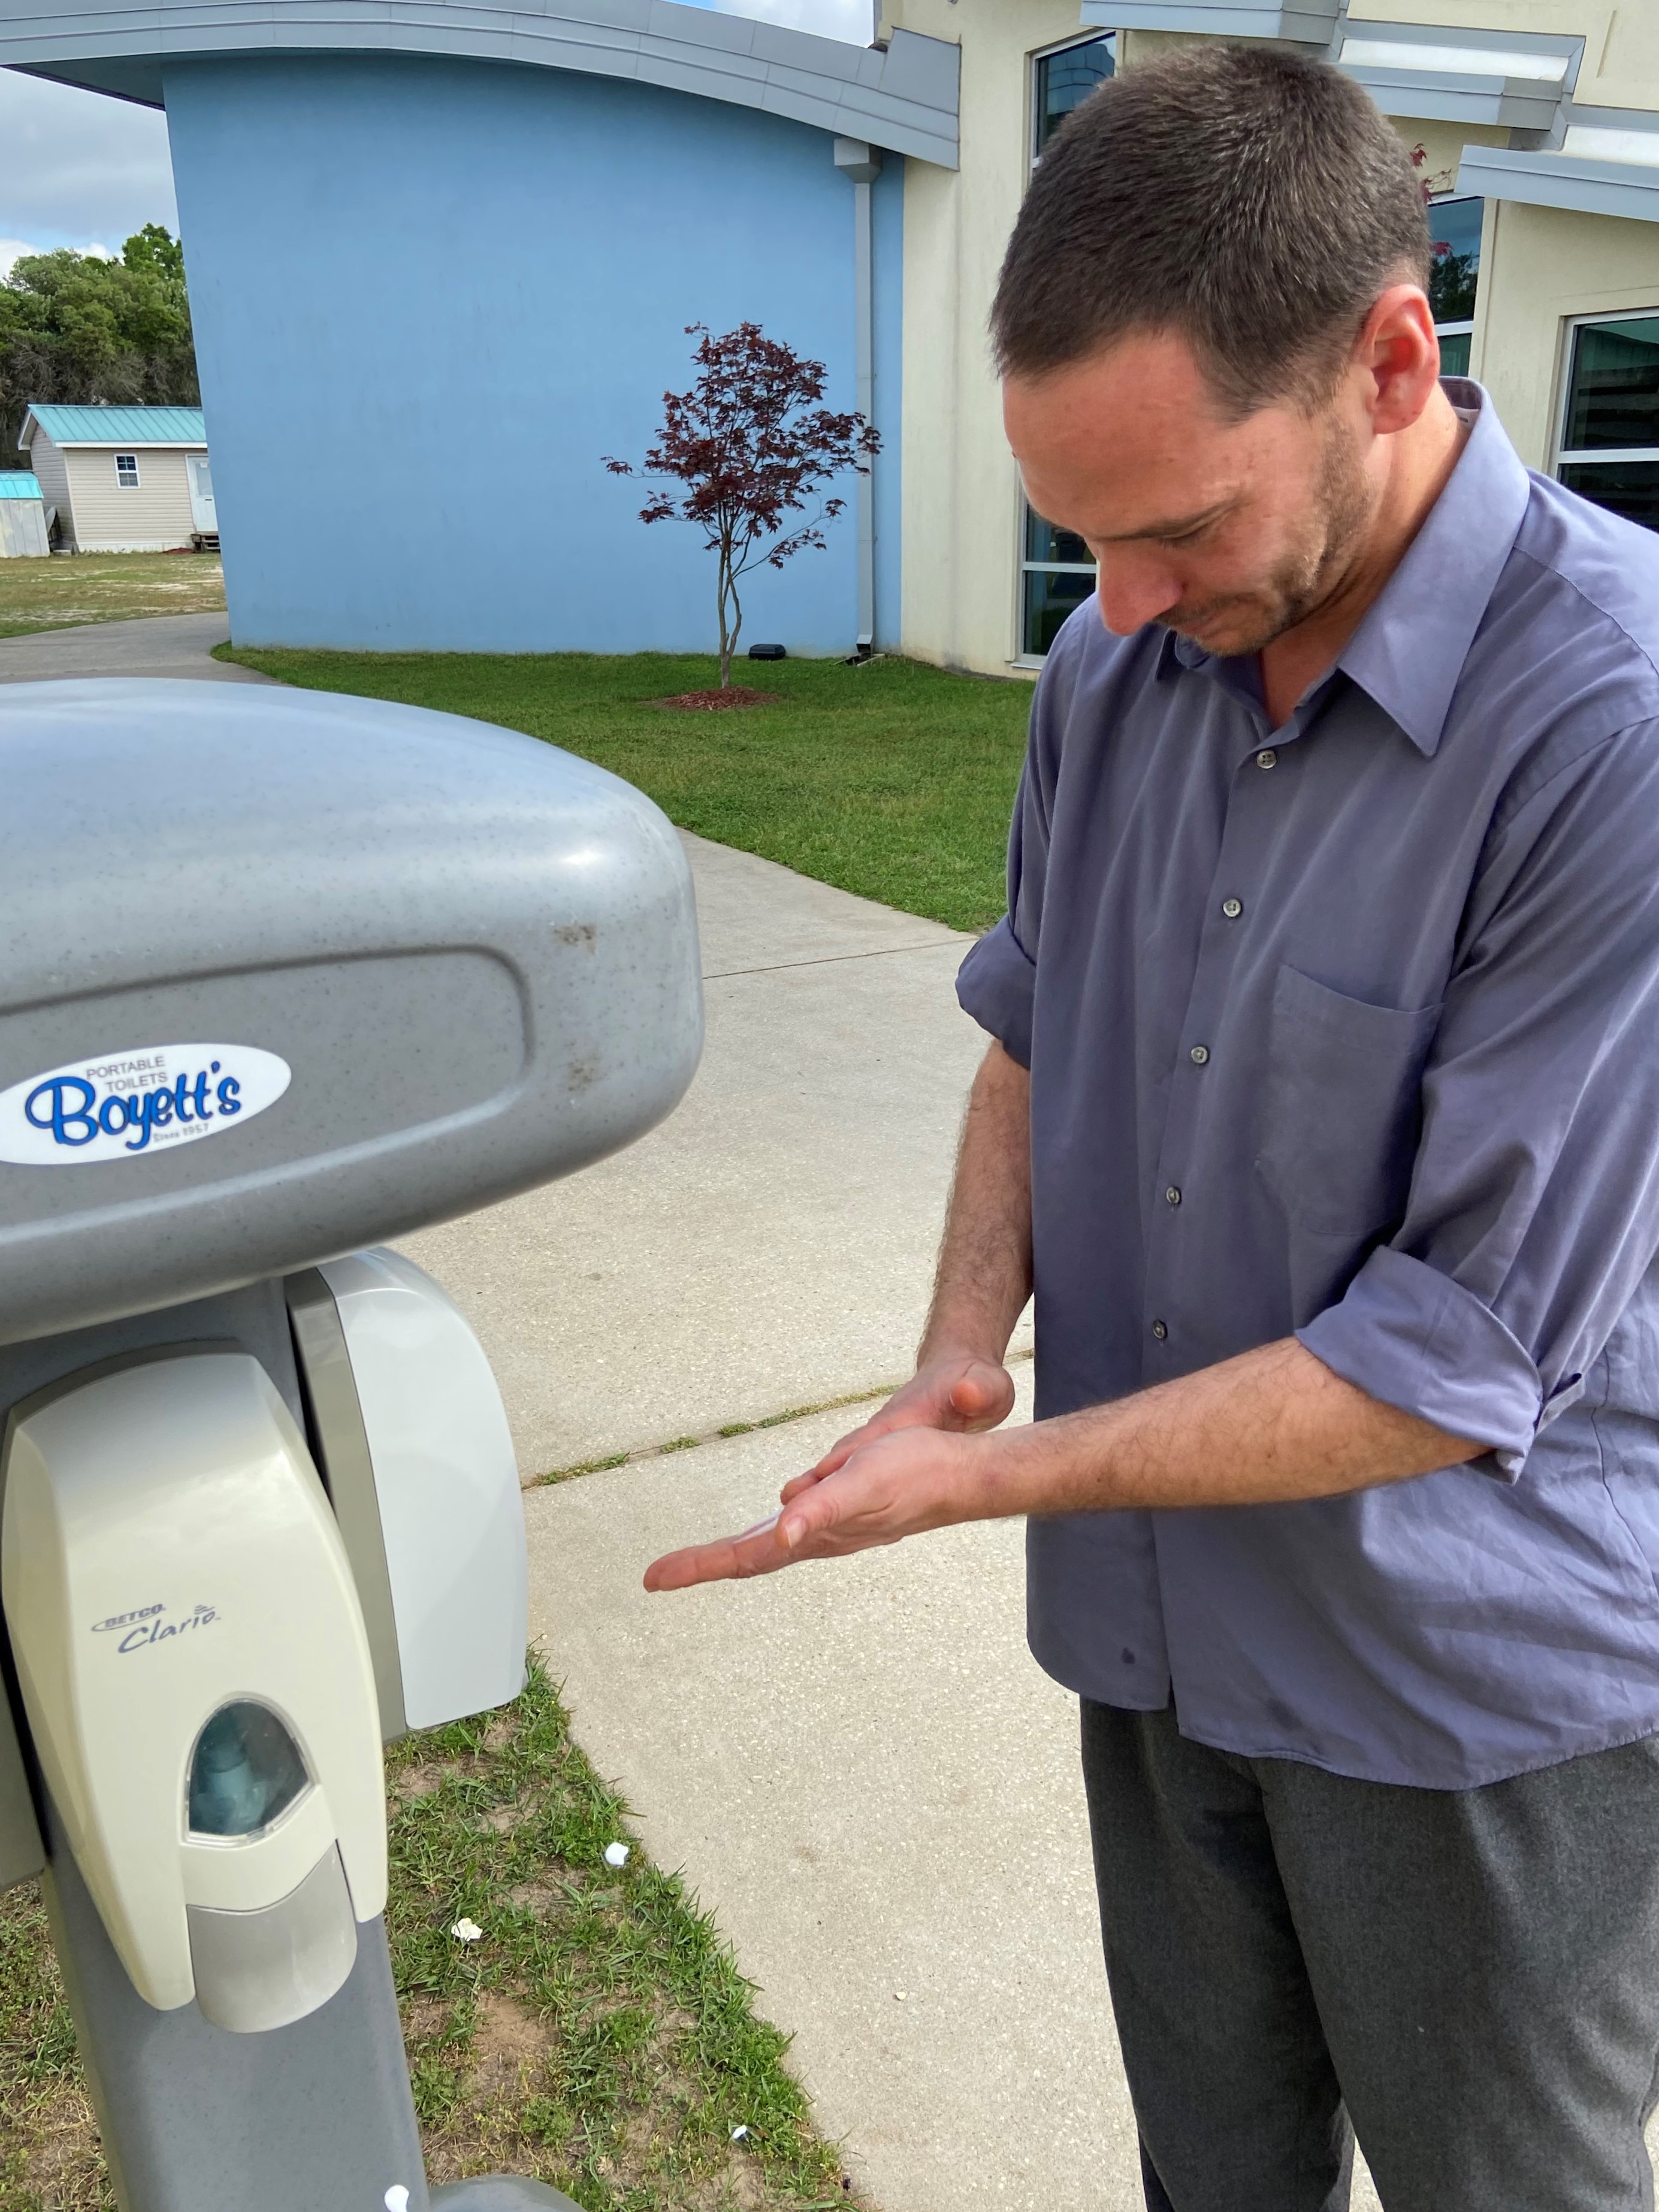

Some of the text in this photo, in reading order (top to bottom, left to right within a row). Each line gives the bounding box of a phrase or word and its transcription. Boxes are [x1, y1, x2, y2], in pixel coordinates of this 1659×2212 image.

[86, 1056, 165, 1079] PORTABLE
[105, 1072, 168, 1093] TOILETS
[25, 1061, 241, 1151] Boyett's
[104, 1603, 163, 1628] BETCO
[117, 1605, 216, 1653] Clario
